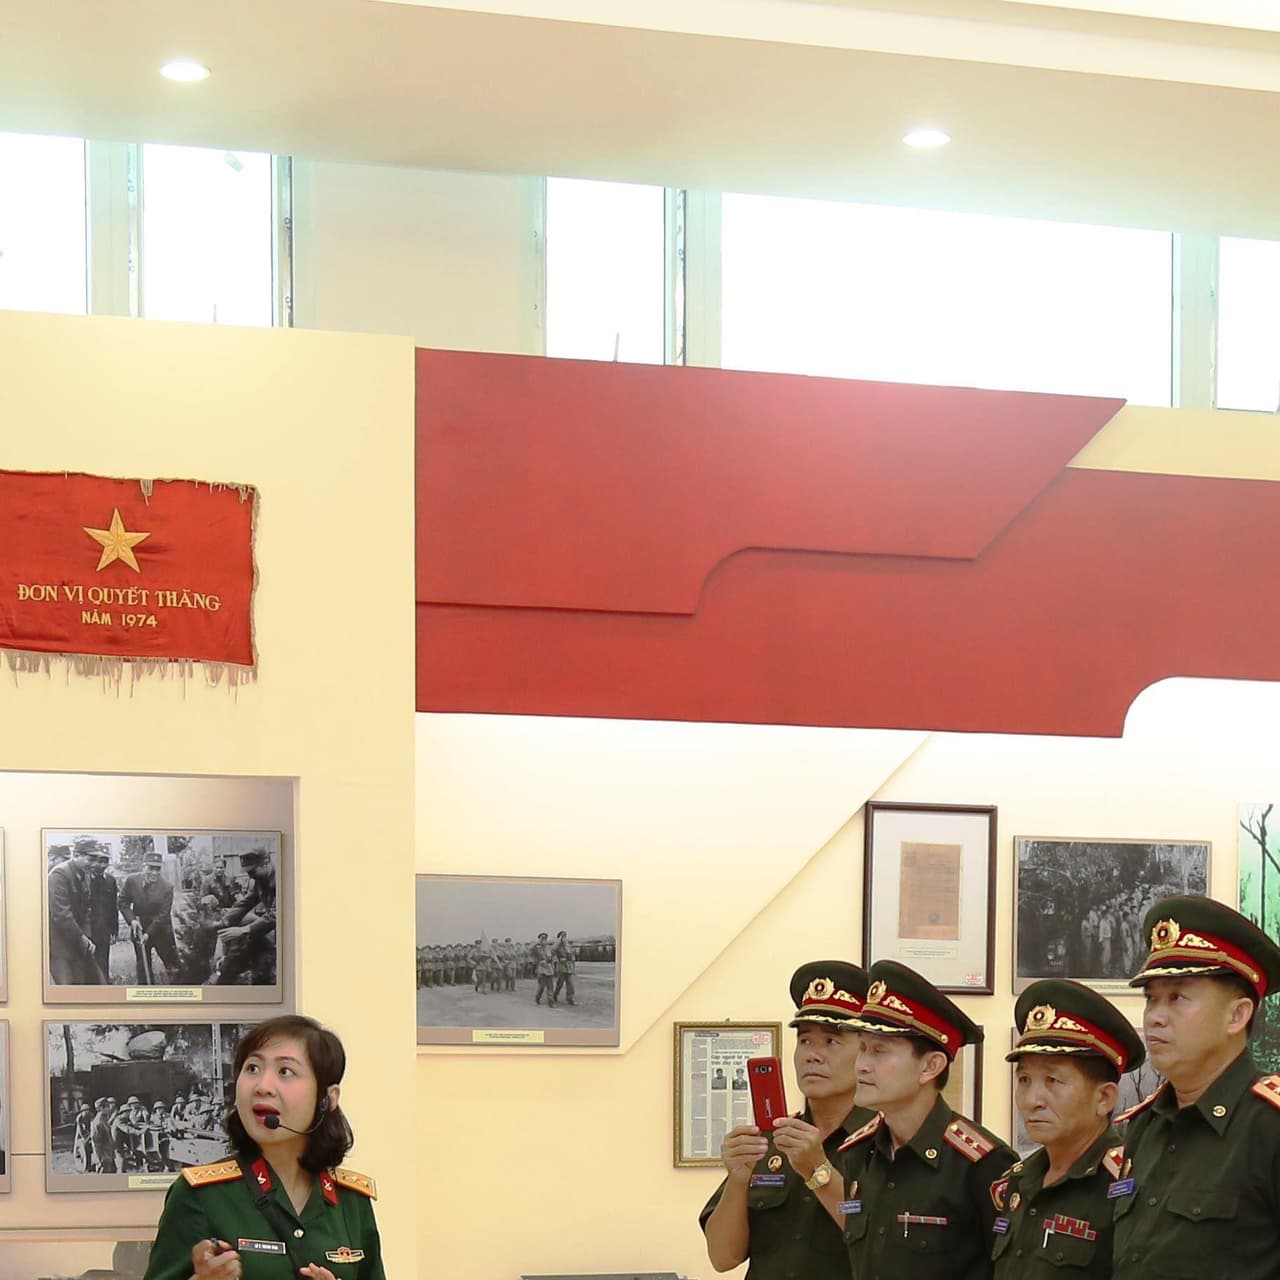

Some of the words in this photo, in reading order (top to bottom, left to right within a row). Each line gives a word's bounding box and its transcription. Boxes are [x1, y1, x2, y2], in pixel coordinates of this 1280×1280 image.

[17, 584, 58, 601] ĐƠN
[63, 585, 84, 605] VỊ
[87, 586, 149, 606] QUYẾT
[122, 613, 158, 628] 1974
